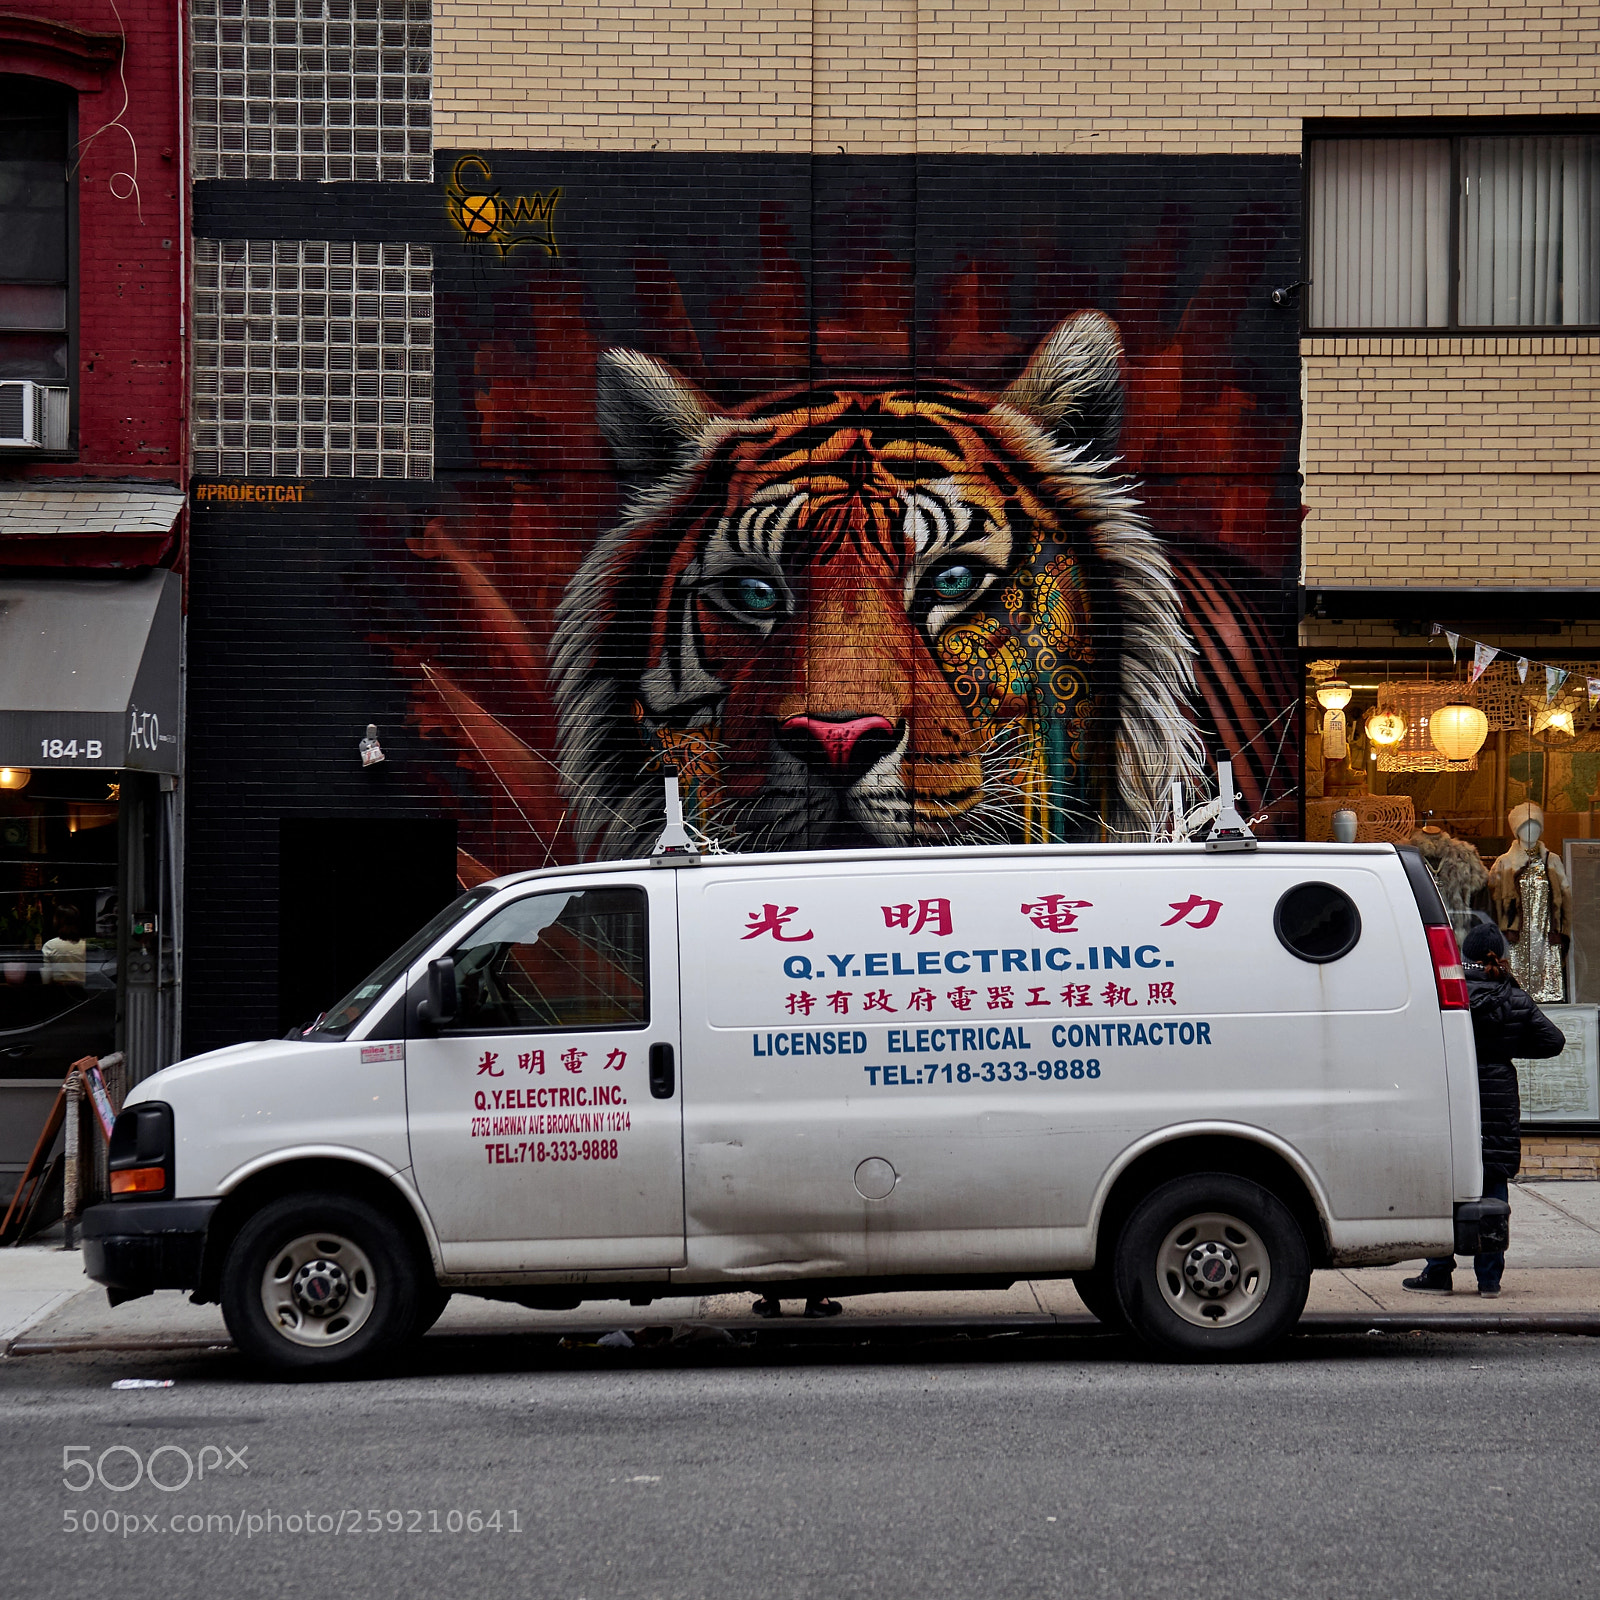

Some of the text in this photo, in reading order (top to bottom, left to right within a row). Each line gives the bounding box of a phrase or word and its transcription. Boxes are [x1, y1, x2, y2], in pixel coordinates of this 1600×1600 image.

[196, 484, 305, 502] #PROJECTCAT
[41, 739, 102, 759] 184-B
[783, 944, 1175, 980] Q.Y.ELECTRIC.INC.
[753, 1021, 1212, 1056] LICENSED ELECTRICAL CONTRACTOR
[864, 1058, 1101, 1086] TEL:718-333-9888
[474, 1085, 628, 1111] Q.Y.ELECTRIC.INC.
[471, 1111, 631, 1137] 2752 HARWAY AVE BROOKLYN NY 11214
[485, 1138, 619, 1164] TEL:718-333-9888
